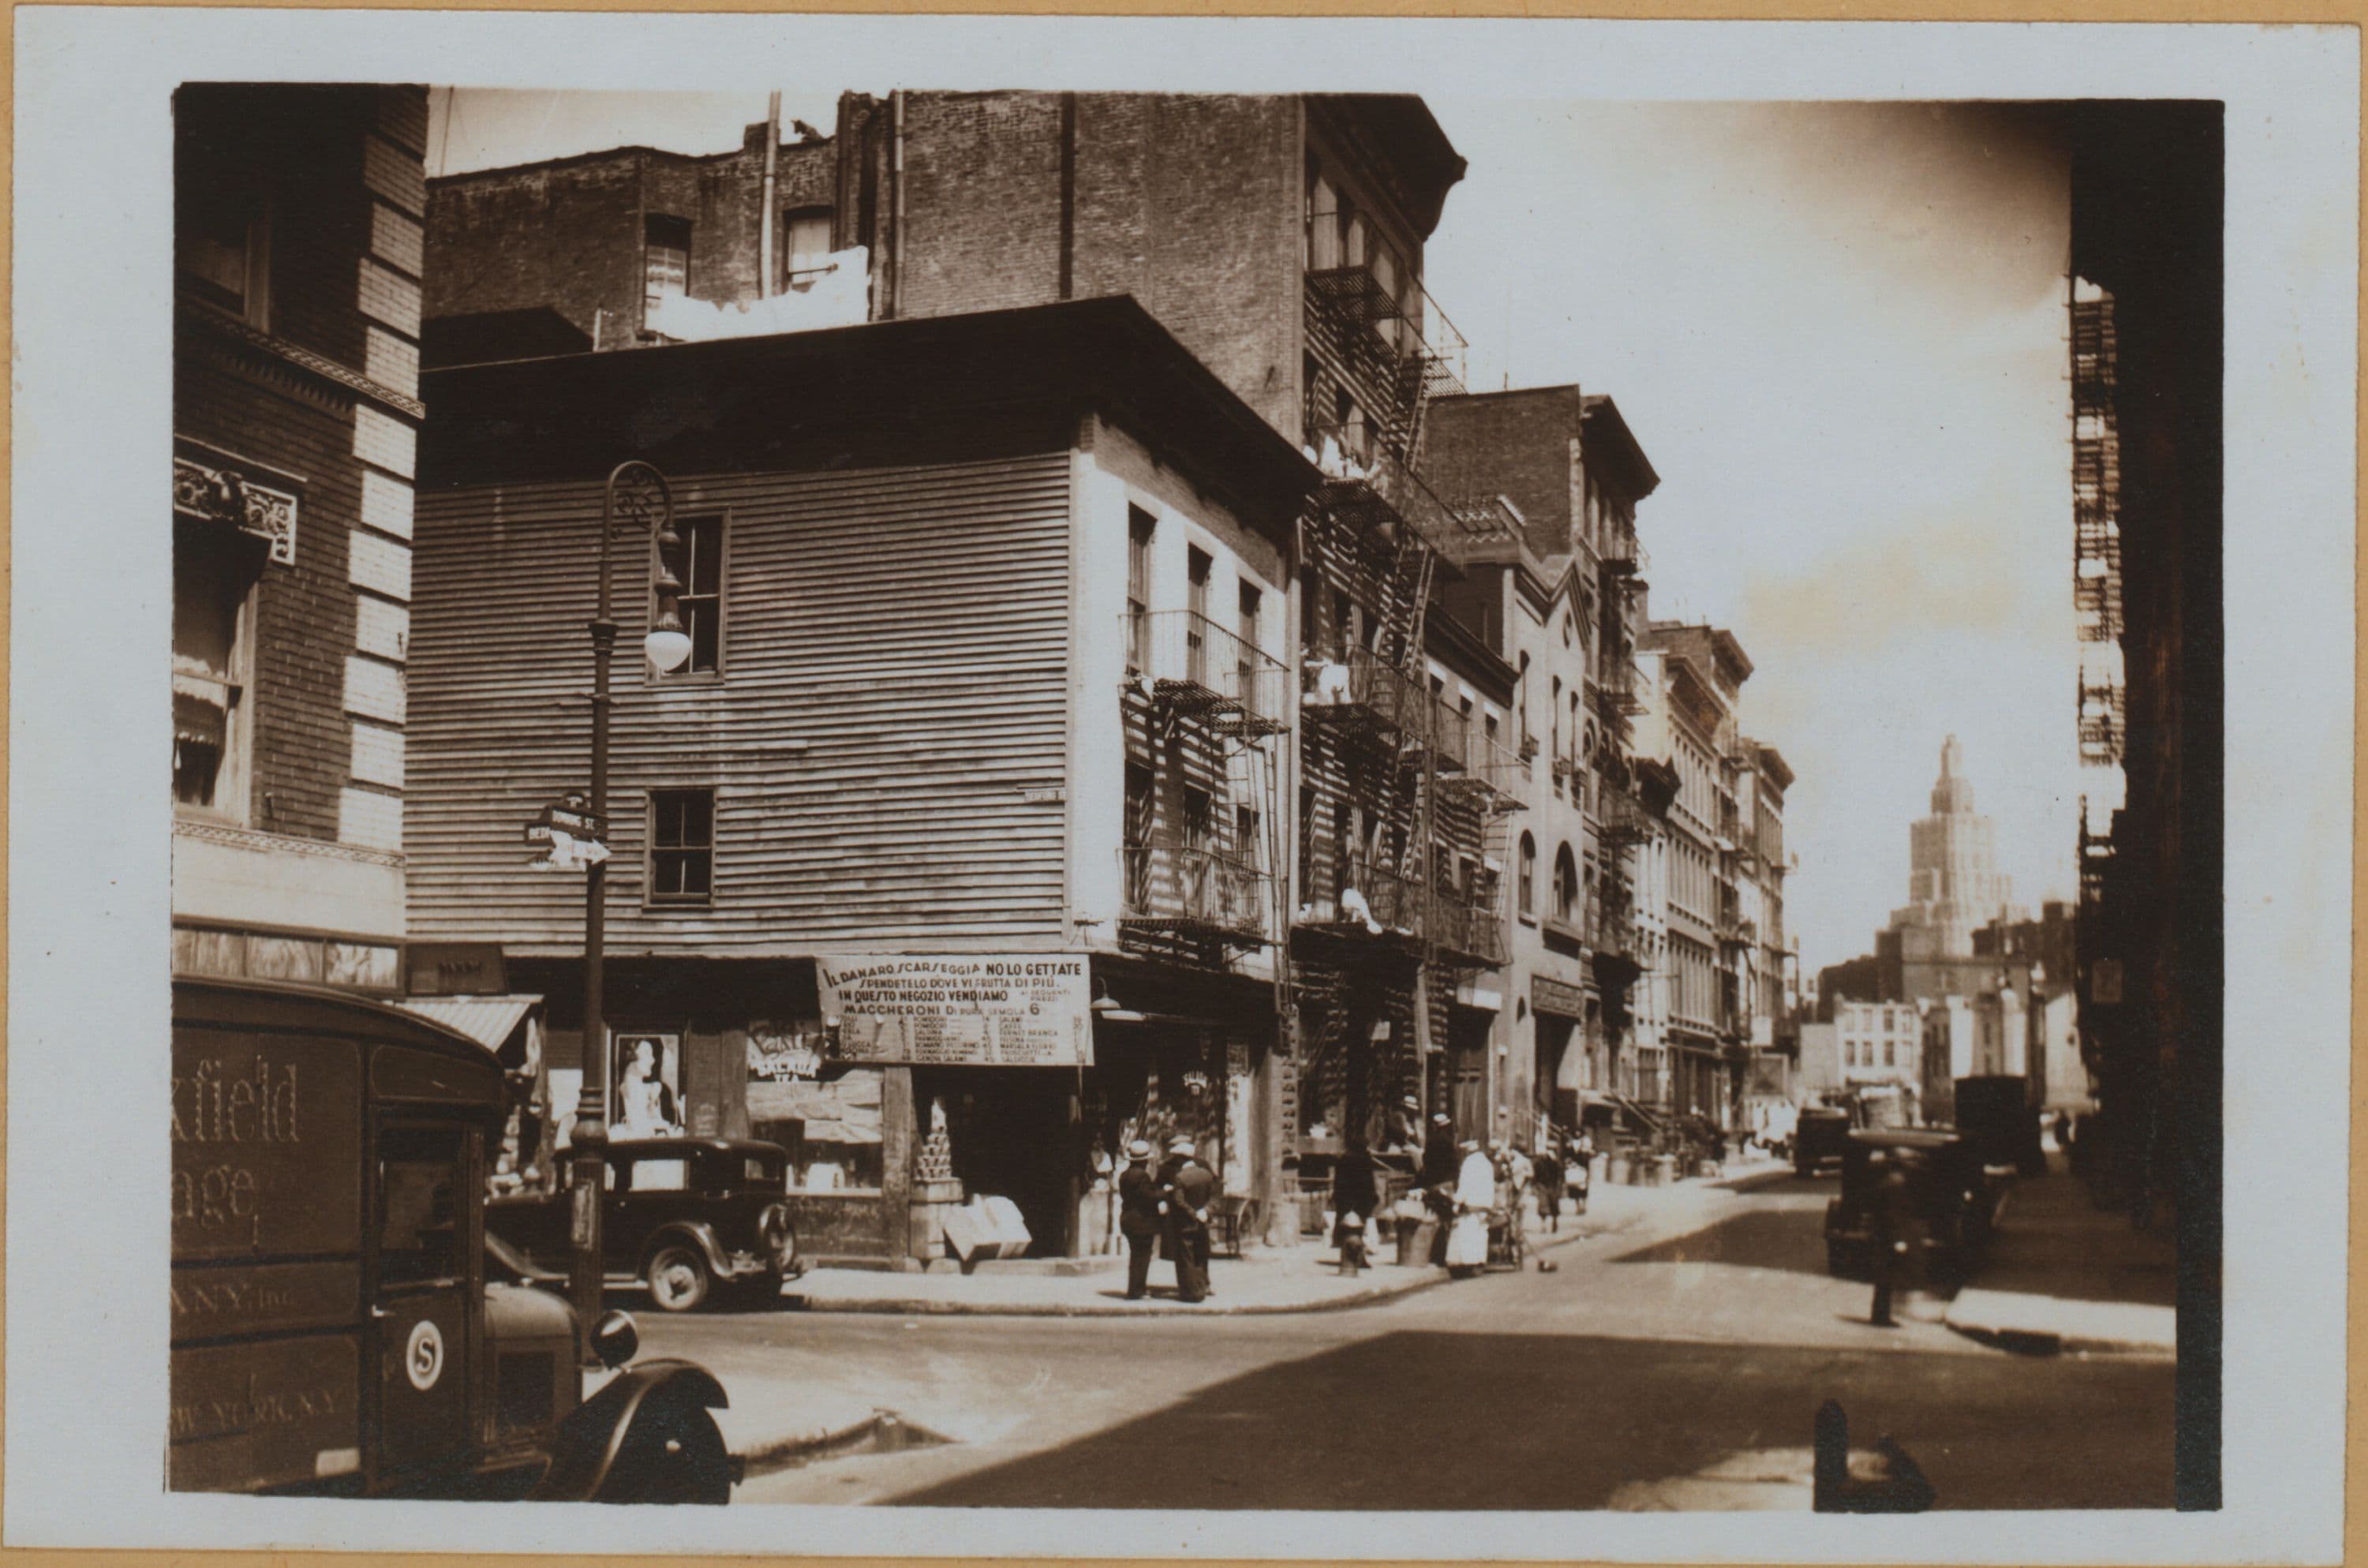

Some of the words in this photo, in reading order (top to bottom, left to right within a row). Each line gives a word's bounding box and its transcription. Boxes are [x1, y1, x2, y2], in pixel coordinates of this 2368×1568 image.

[823, 968, 840, 988] IL
[840, 964, 894, 982] DANARO
[897, 963, 980, 976] SCARSEGGIA
[986, 964, 1005, 975] NO
[1007, 964, 1022, 975] LO
[1026, 963, 1081, 975] GETTATE
[859, 978, 926, 989] SPENDETELO
[930, 978, 958, 989] DOVE
[961, 978, 972, 989] VI
[975, 978, 1011, 988] FRUTTA
[1016, 977, 1028, 988] DI
[839, 991, 852, 1001] IN
[855, 990, 896, 1003] QUESTO
[900, 990, 946, 1001] NEGOZIO
[948, 990, 1008, 1002] VENDIAMO
[844, 1005, 940, 1015] MACCHERONI
[1029, 1003, 1040, 1016] 6
[416, 1337, 435, 1375] S
